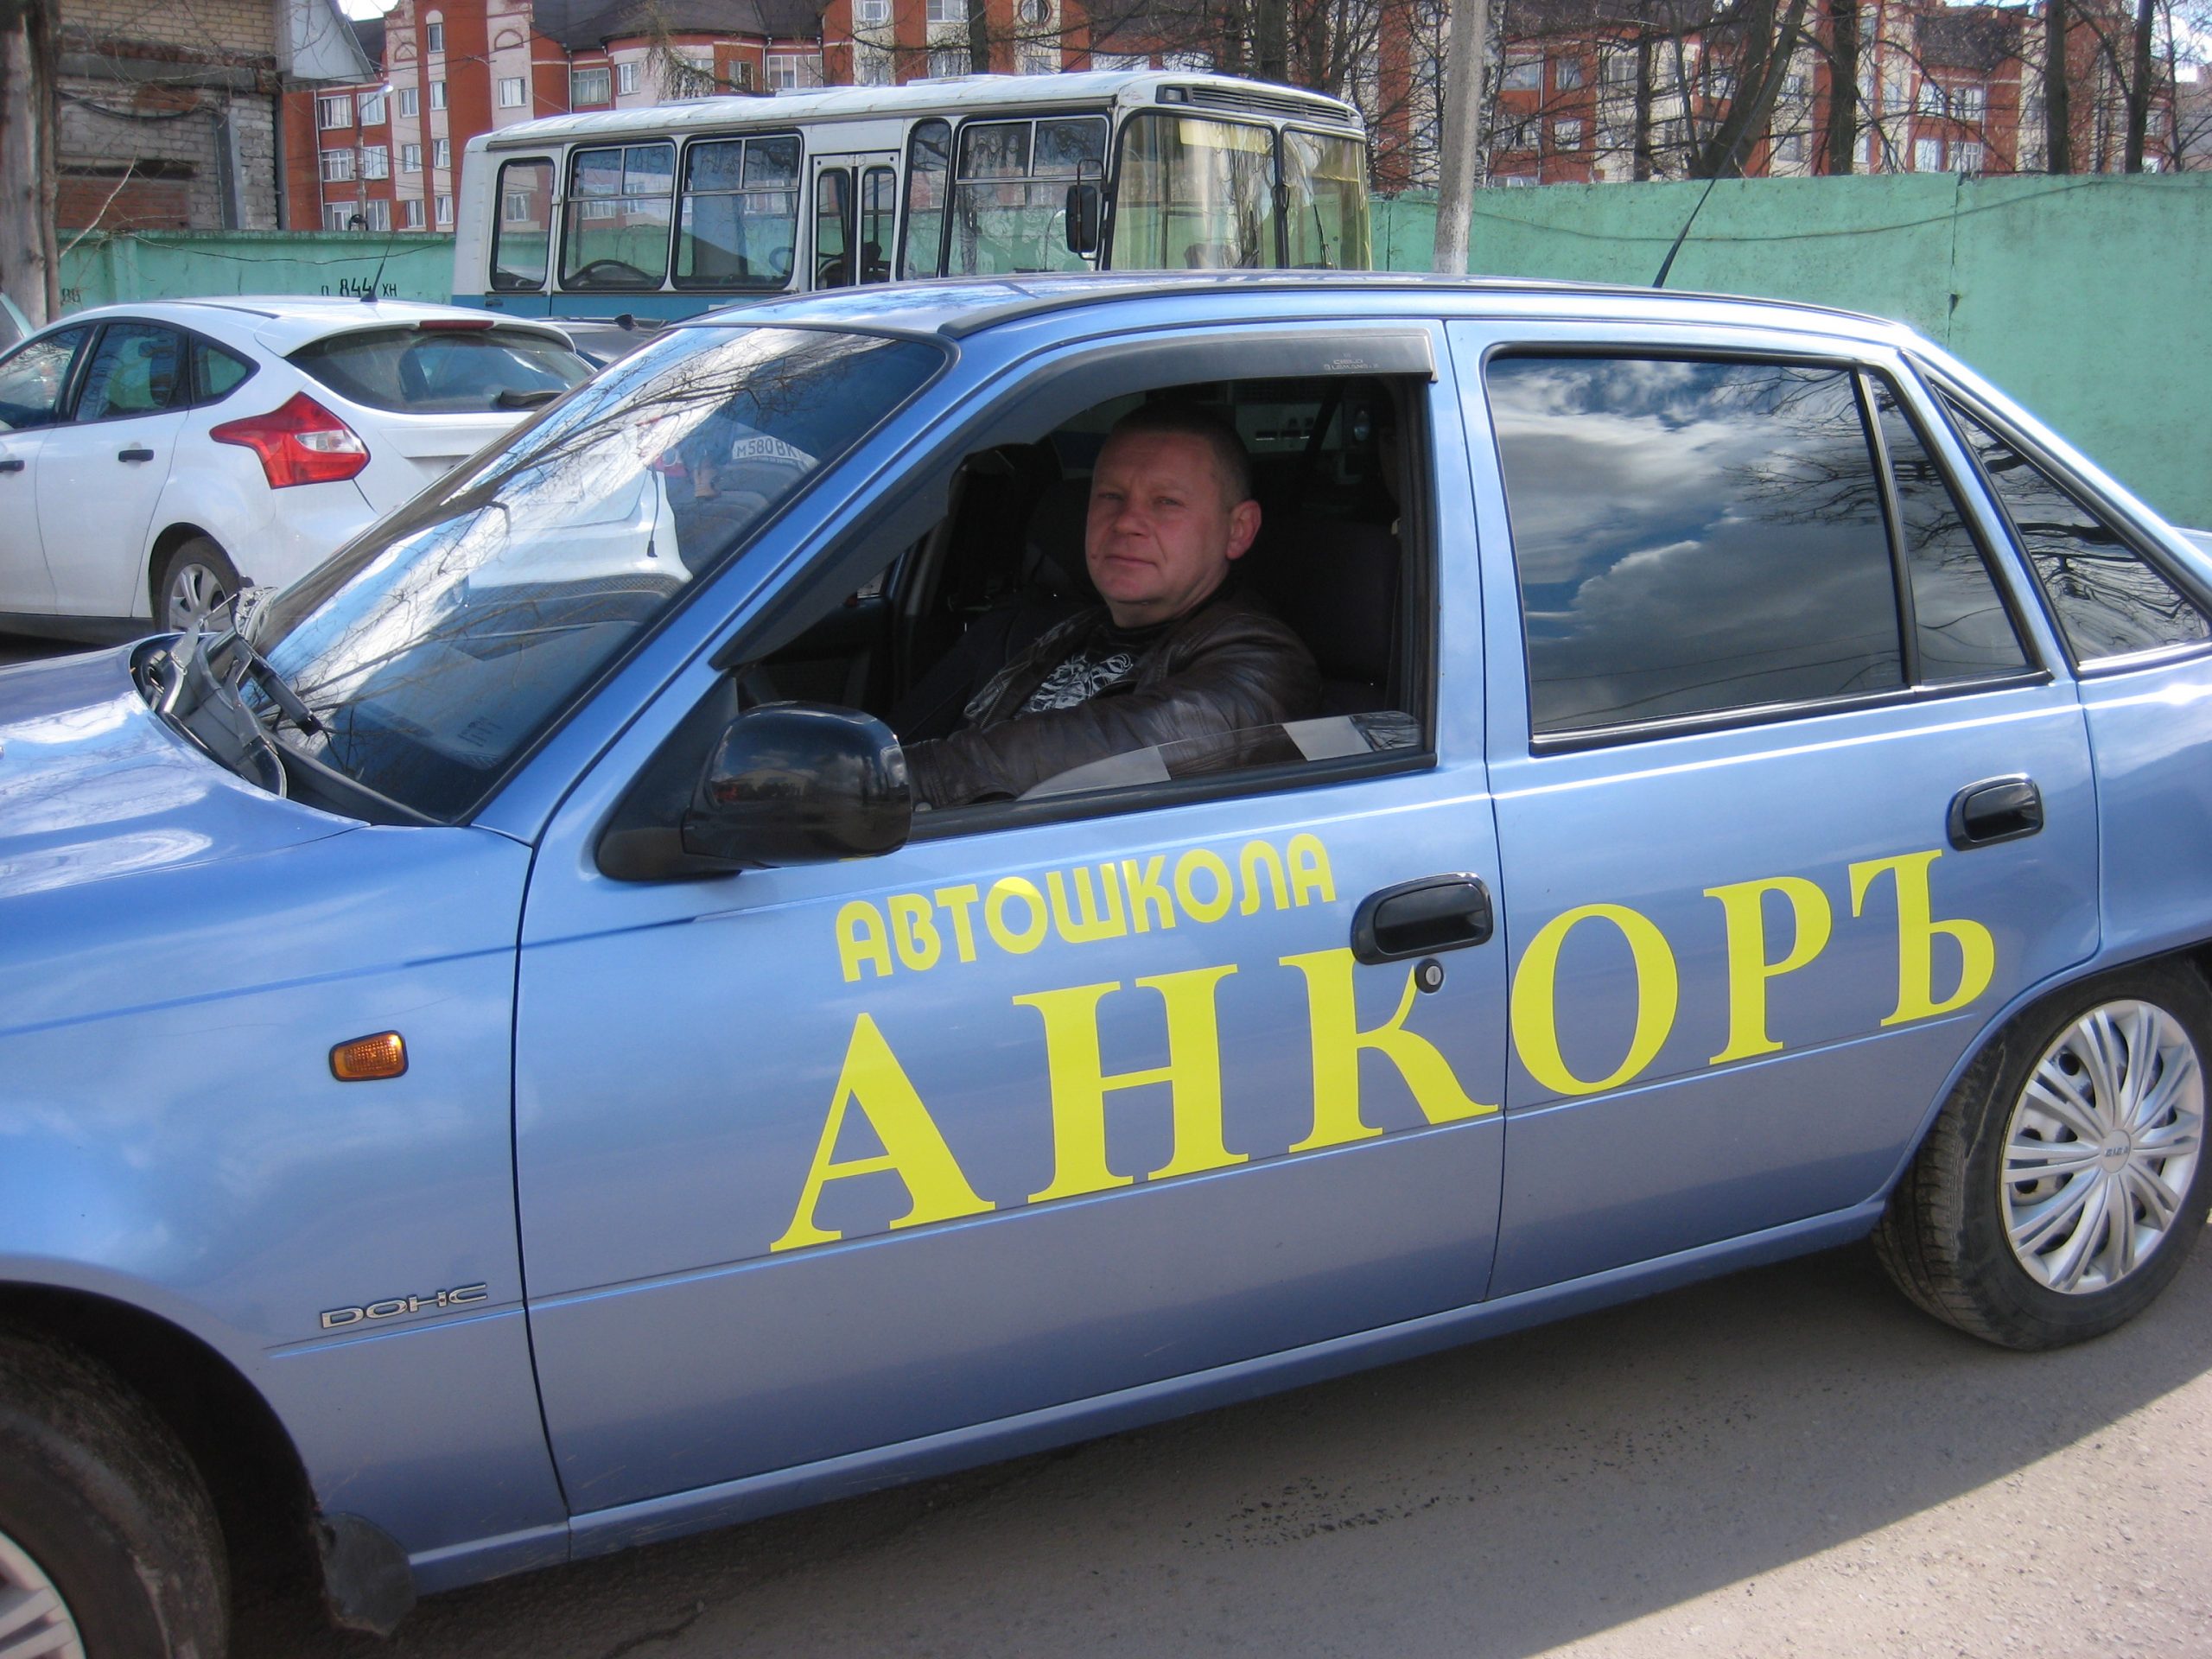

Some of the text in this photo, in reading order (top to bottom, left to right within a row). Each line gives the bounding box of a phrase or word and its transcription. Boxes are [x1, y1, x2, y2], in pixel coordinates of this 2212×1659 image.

[339, 276, 372, 298] 844
[835, 833, 1337, 982] АВТОШКОЛА
[769, 849, 1996, 1253] АНКОРЪ
[321, 1282, 488, 1330] DOHC
